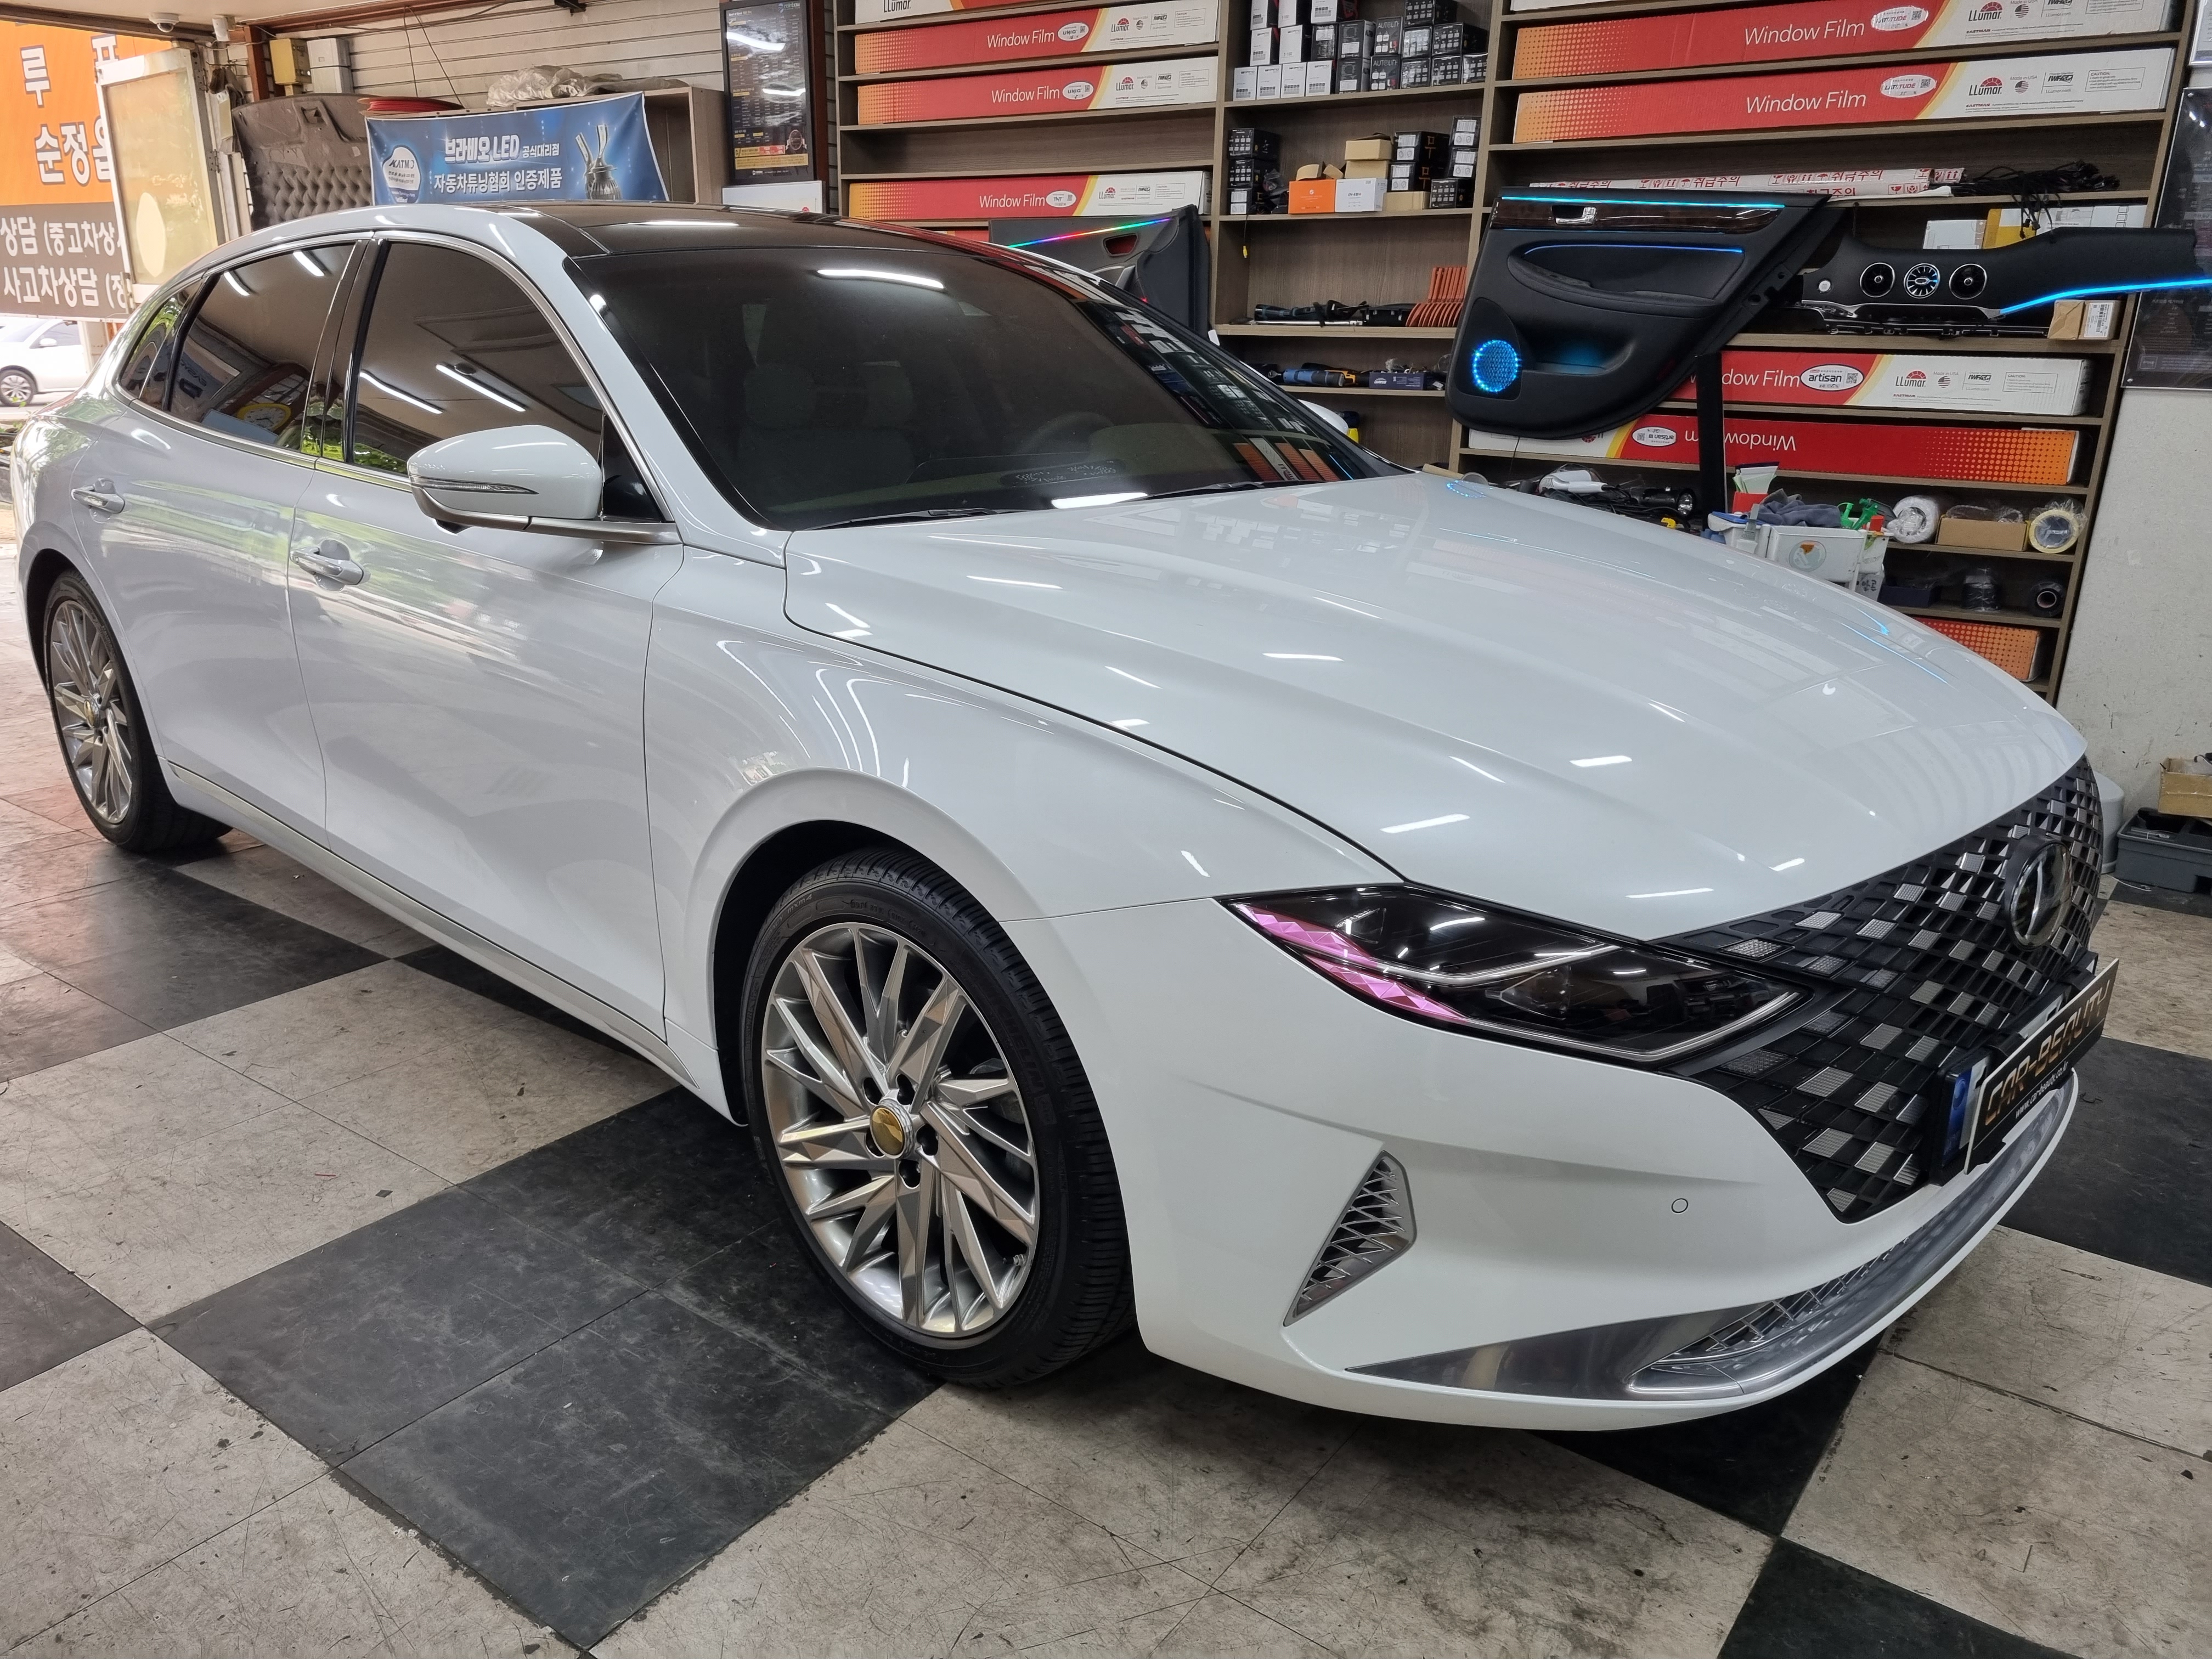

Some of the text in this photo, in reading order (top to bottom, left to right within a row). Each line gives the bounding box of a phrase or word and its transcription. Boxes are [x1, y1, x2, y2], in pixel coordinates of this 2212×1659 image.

[884, 0, 910, 13] LLumar
[1968, 10, 2002, 21] LLumar
[1111, 24, 1129, 32] LLumar
[1746, 19, 1865, 45] Window Film
[988, 29, 1055, 48] Window Film
[20, 45, 51, 108] 루
[1116, 82, 1135, 91] LLumar
[1968, 84, 2002, 96] LLumar
[991, 86, 1060, 104] Window Film
[1747, 90, 1866, 114] Window Film
[444, 134, 560, 163] 브라비오 LED 공식대리점
[388, 159, 415, 169] KATMO
[433, 167, 563, 194] 자동차튜닝협회 인증제품
[1694, 176, 1740, 188] 취급주의
[1831, 170, 1884, 182] 취급주의
[979, 193, 1045, 208] Window Film
[0, 216, 121, 257] 상담 (중고차상
[1722, 369, 1801, 388] dow Film
[1808, 373, 1842, 382] artisan
[1895, 375, 1926, 387] LLumar
[1724, 431, 1796, 452] Window
[1985, 979, 2111, 1126] CAR-BEAUTY
